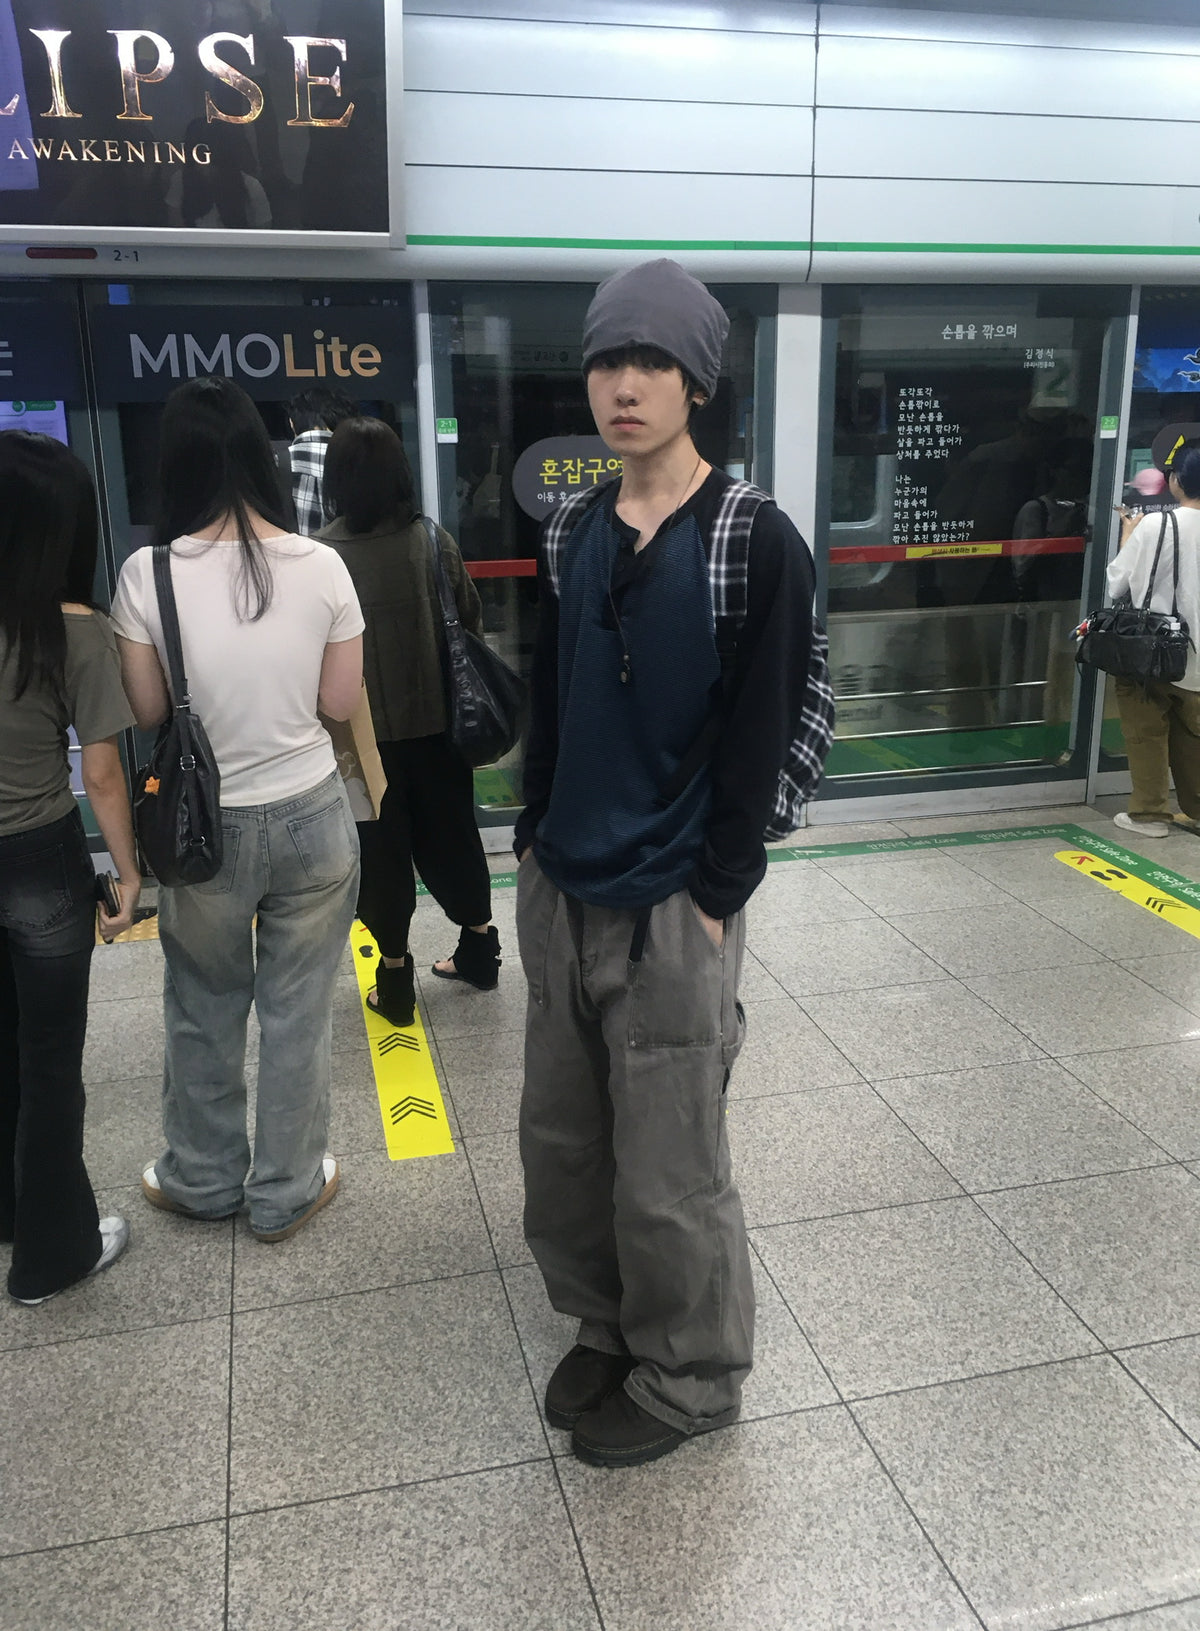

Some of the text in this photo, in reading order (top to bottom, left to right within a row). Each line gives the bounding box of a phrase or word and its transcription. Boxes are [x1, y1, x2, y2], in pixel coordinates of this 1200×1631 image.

[0, 28, 355, 128] IPSE
[8, 137, 212, 165] AWAKENING
[114, 250, 139, 262] 2-1
[941, 323, 1017, 340] 손톱을 깎으며
[129, 329, 382, 378] MMOLite
[899, 387, 933, 397] 또각또각
[898, 400, 940, 410] 손톱깎이로
[898, 412, 944, 422] 모난 손톱을
[898, 424, 960, 435] 반듯하게 깎다가
[896, 436, 962, 448] 살을 파고 들어가
[896, 448, 950, 460] 상처를 주었다
[895, 474, 912, 484] 나는
[894, 486, 928, 496] 누군가의
[537, 492, 556, 503] 이동
[894, 498, 928, 508] 마음속에
[894, 510, 938, 520] 파고 들어가
[893, 520, 974, 532] 모난 손톱을 반듯하게
[893, 532, 970, 544] 깎아 주진 않았는가?
